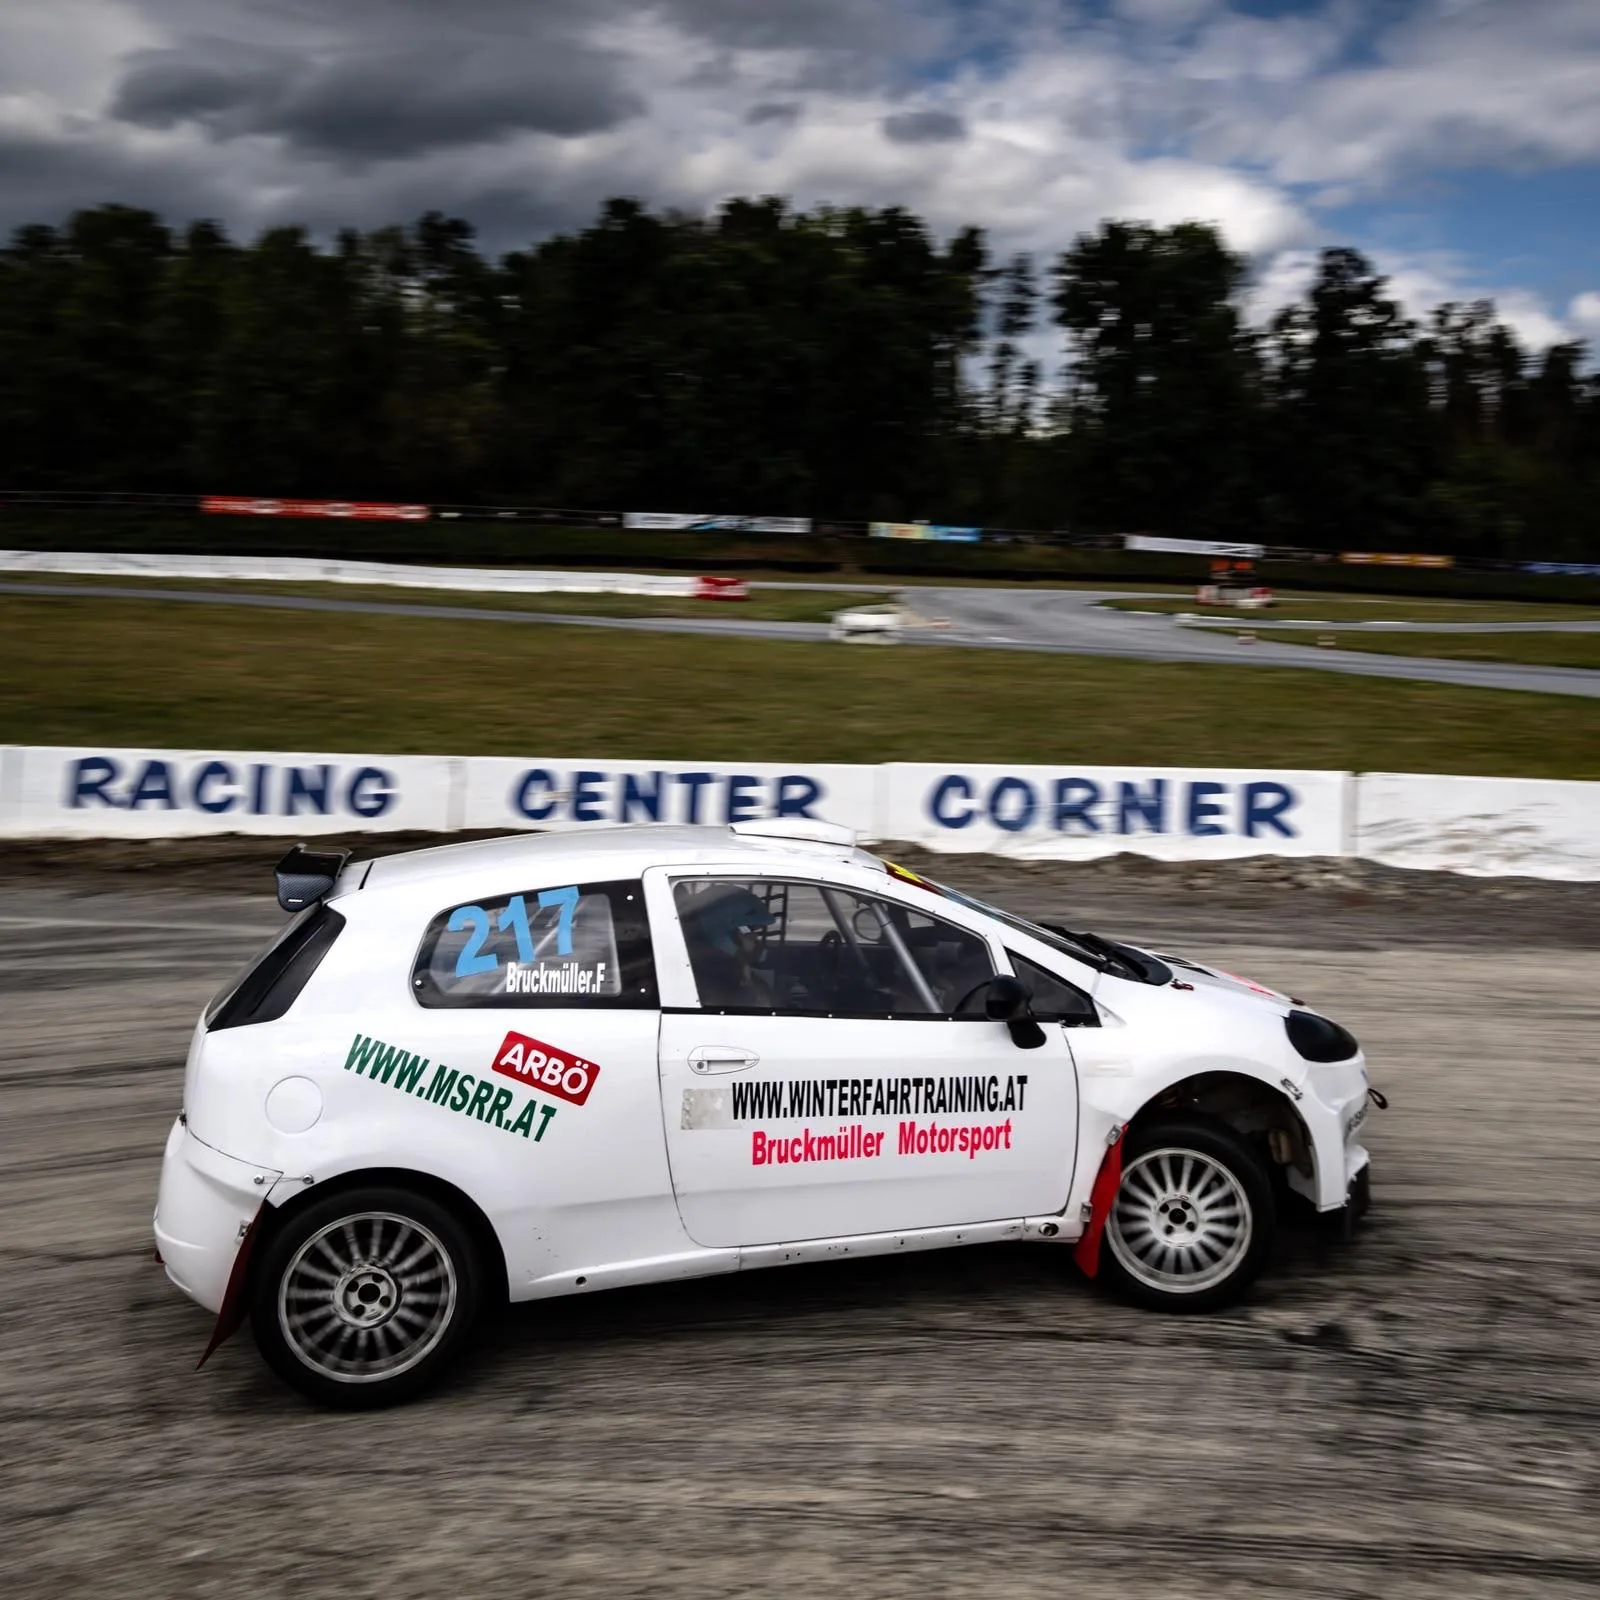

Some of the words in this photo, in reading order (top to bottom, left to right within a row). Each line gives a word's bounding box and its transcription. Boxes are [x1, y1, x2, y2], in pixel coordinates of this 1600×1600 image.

[64, 756, 397, 818] RACING
[509, 768, 825, 825] CENTER
[927, 774, 1304, 838] CORNER
[448, 886, 580, 978] 217
[506, 962, 606, 994] Bruckmüller.F
[344, 1033, 558, 1143] WWW.MSRR.AT
[499, 1043, 588, 1095] ARBÖ
[732, 1075, 1028, 1121] WWW.WINTERFAHRTRAINING.AT
[752, 1125, 885, 1166] Bruckmüller
[898, 1118, 1012, 1160] Motorsport
